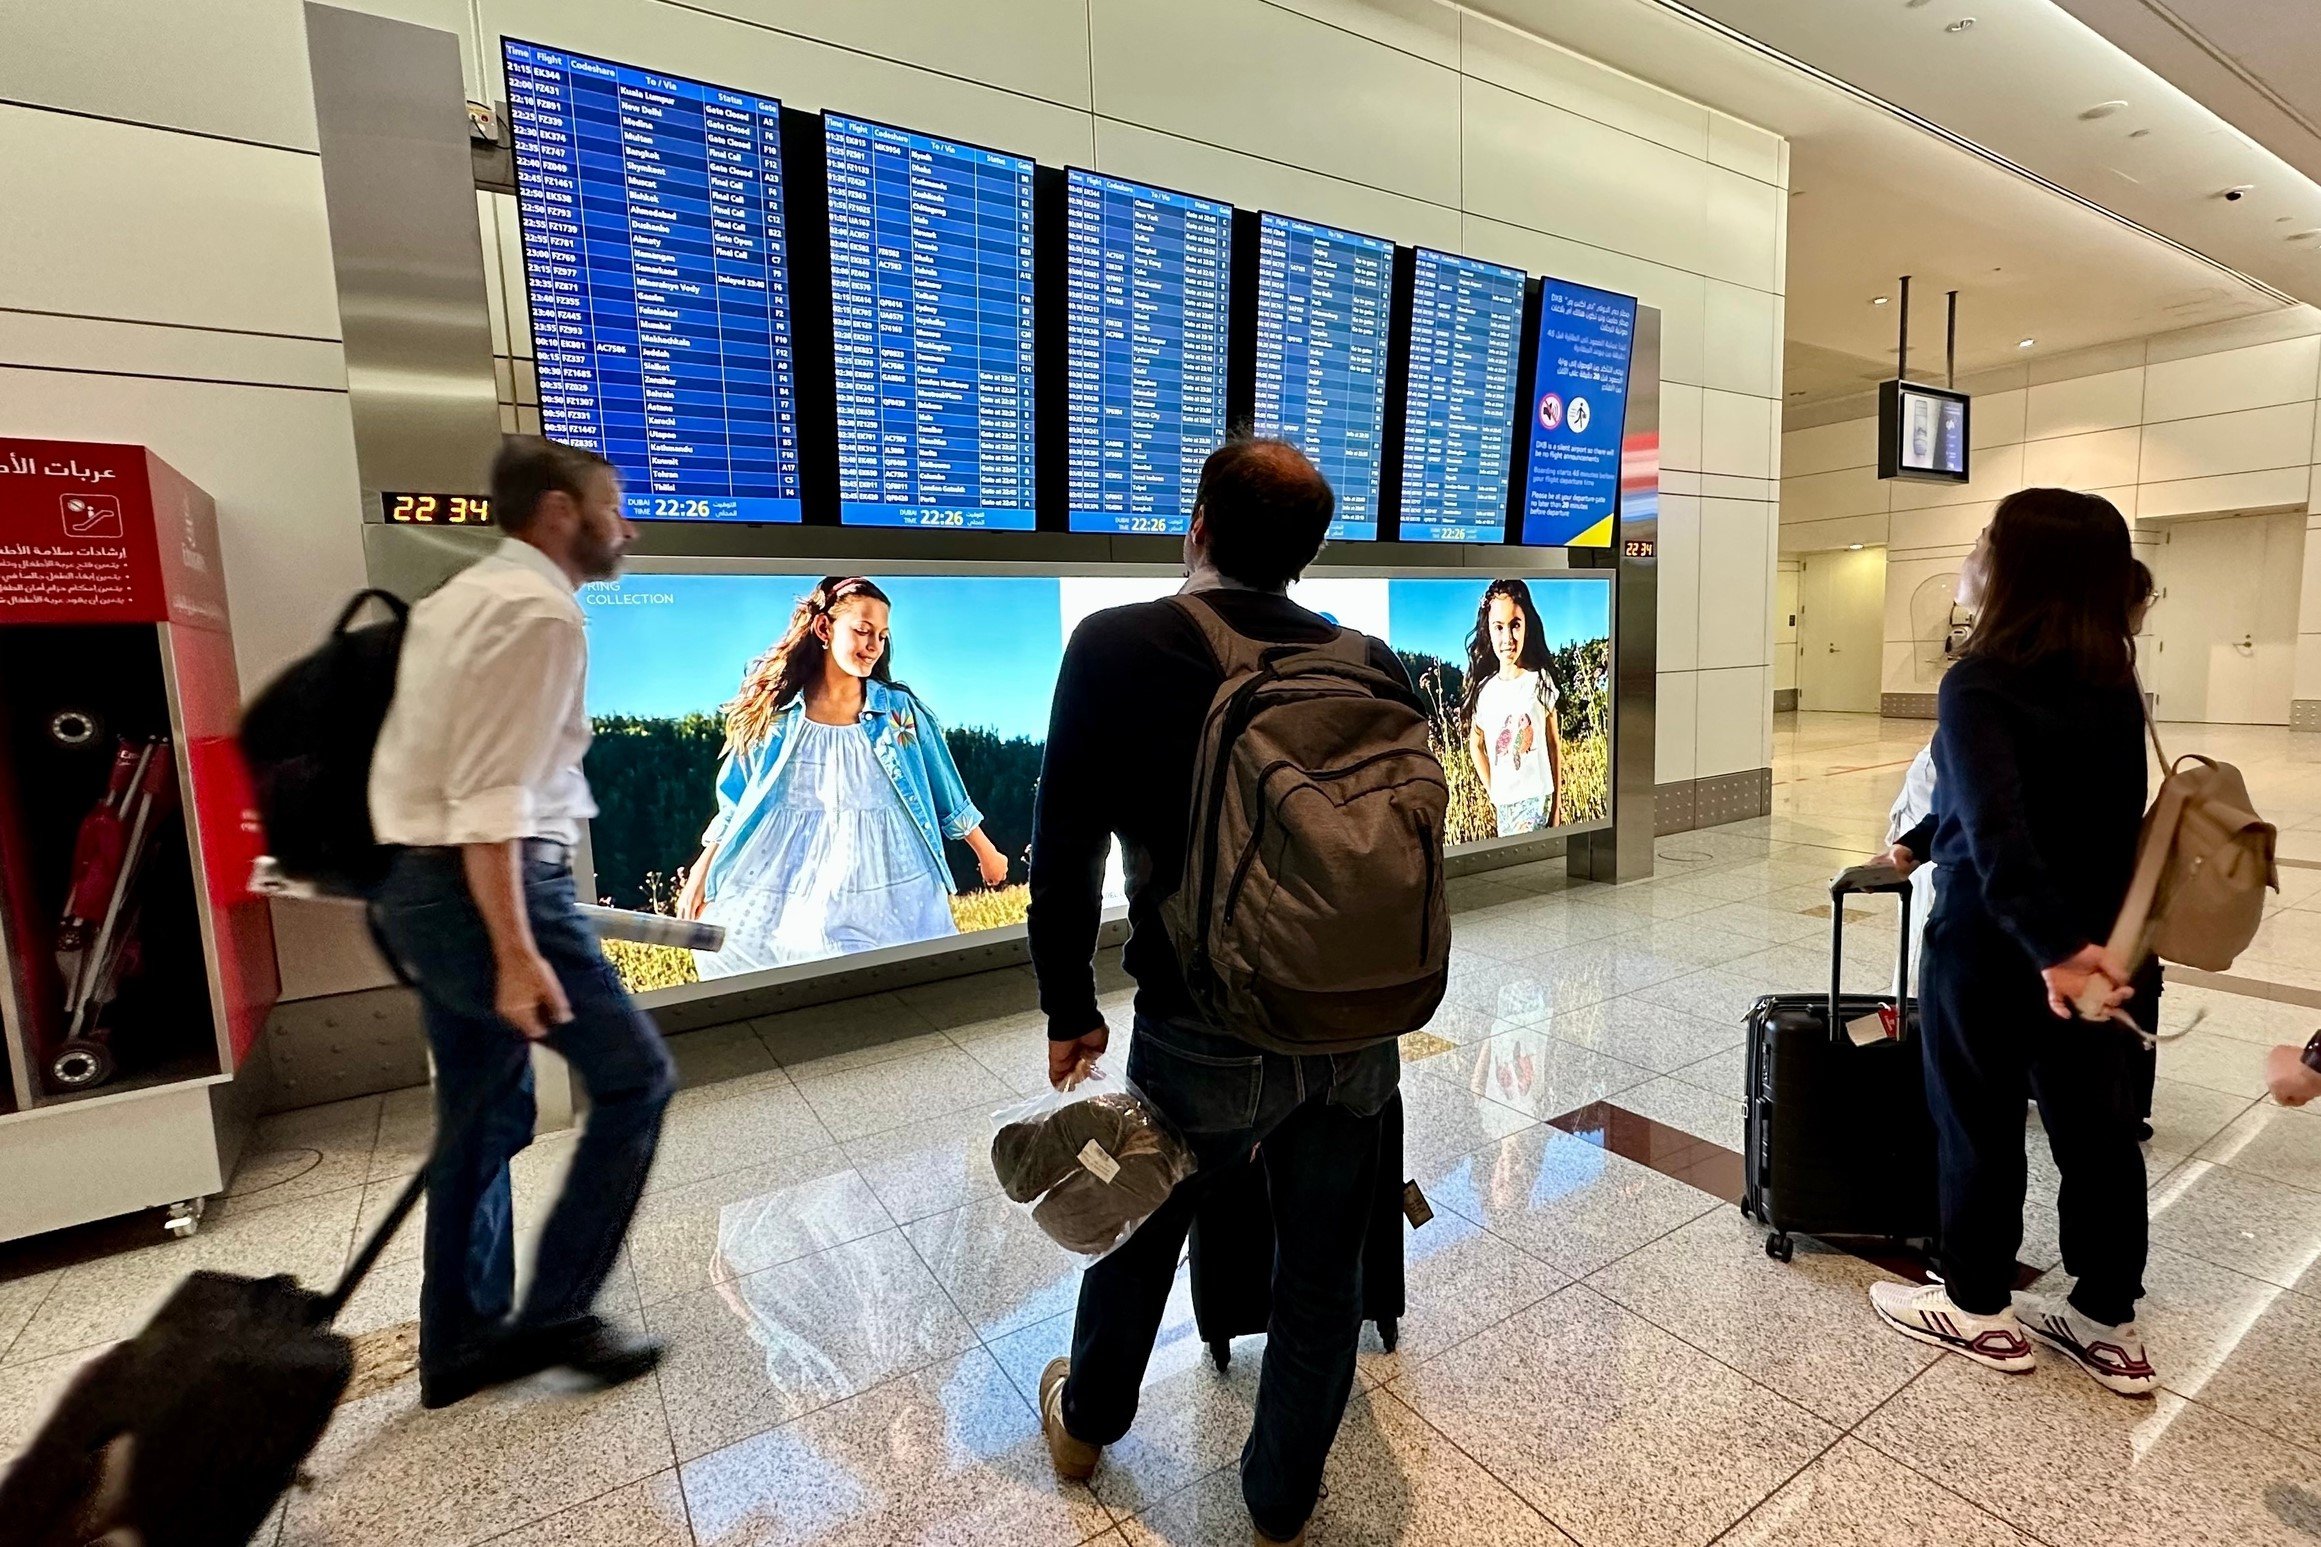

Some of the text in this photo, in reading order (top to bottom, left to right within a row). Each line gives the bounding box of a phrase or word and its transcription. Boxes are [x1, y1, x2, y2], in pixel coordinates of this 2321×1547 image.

[505, 44, 777, 112] Time Flight Codeshare To Via Status Gate
[506, 61, 532, 74] 21:15
[705, 105, 724, 116] Gate
[724, 109, 749, 121] Closed
[508, 77, 533, 89] 22:00
[706, 119, 725, 130] Gate
[725, 123, 750, 135] Closed
[510, 93, 535, 106] 22:10
[707, 134, 726, 144] Gate
[726, 138, 751, 150] Closed
[511, 108, 536, 121] 22:25
[708, 148, 727, 158] Final
[727, 152, 741, 161] Call
[513, 124, 538, 137] 22:30
[709, 162, 728, 173] Gate
[728, 166, 753, 178] Closed
[516, 156, 541, 168] 22:40
[711, 190, 730, 201] Final
[729, 194, 744, 204] Call
[710, 176, 728, 187] Final
[729, 180, 743, 190] Call
[717, 275, 746, 286] Delayed
[535, 337, 558, 346] 00:10
[44, 460, 116, 483] عربات
[393, 496, 488, 523] 22 34
[628, 498, 710, 518] DUBAI 22:26
[920, 510, 964, 525] 22:26
[1131, 517, 1166, 532] 22:26
[1441, 528, 1465, 540] 22:26
[33, 546, 73, 556] سلامة
[77, 546, 127, 559] إرشادات
[587, 594, 674, 605] COLLECTION
